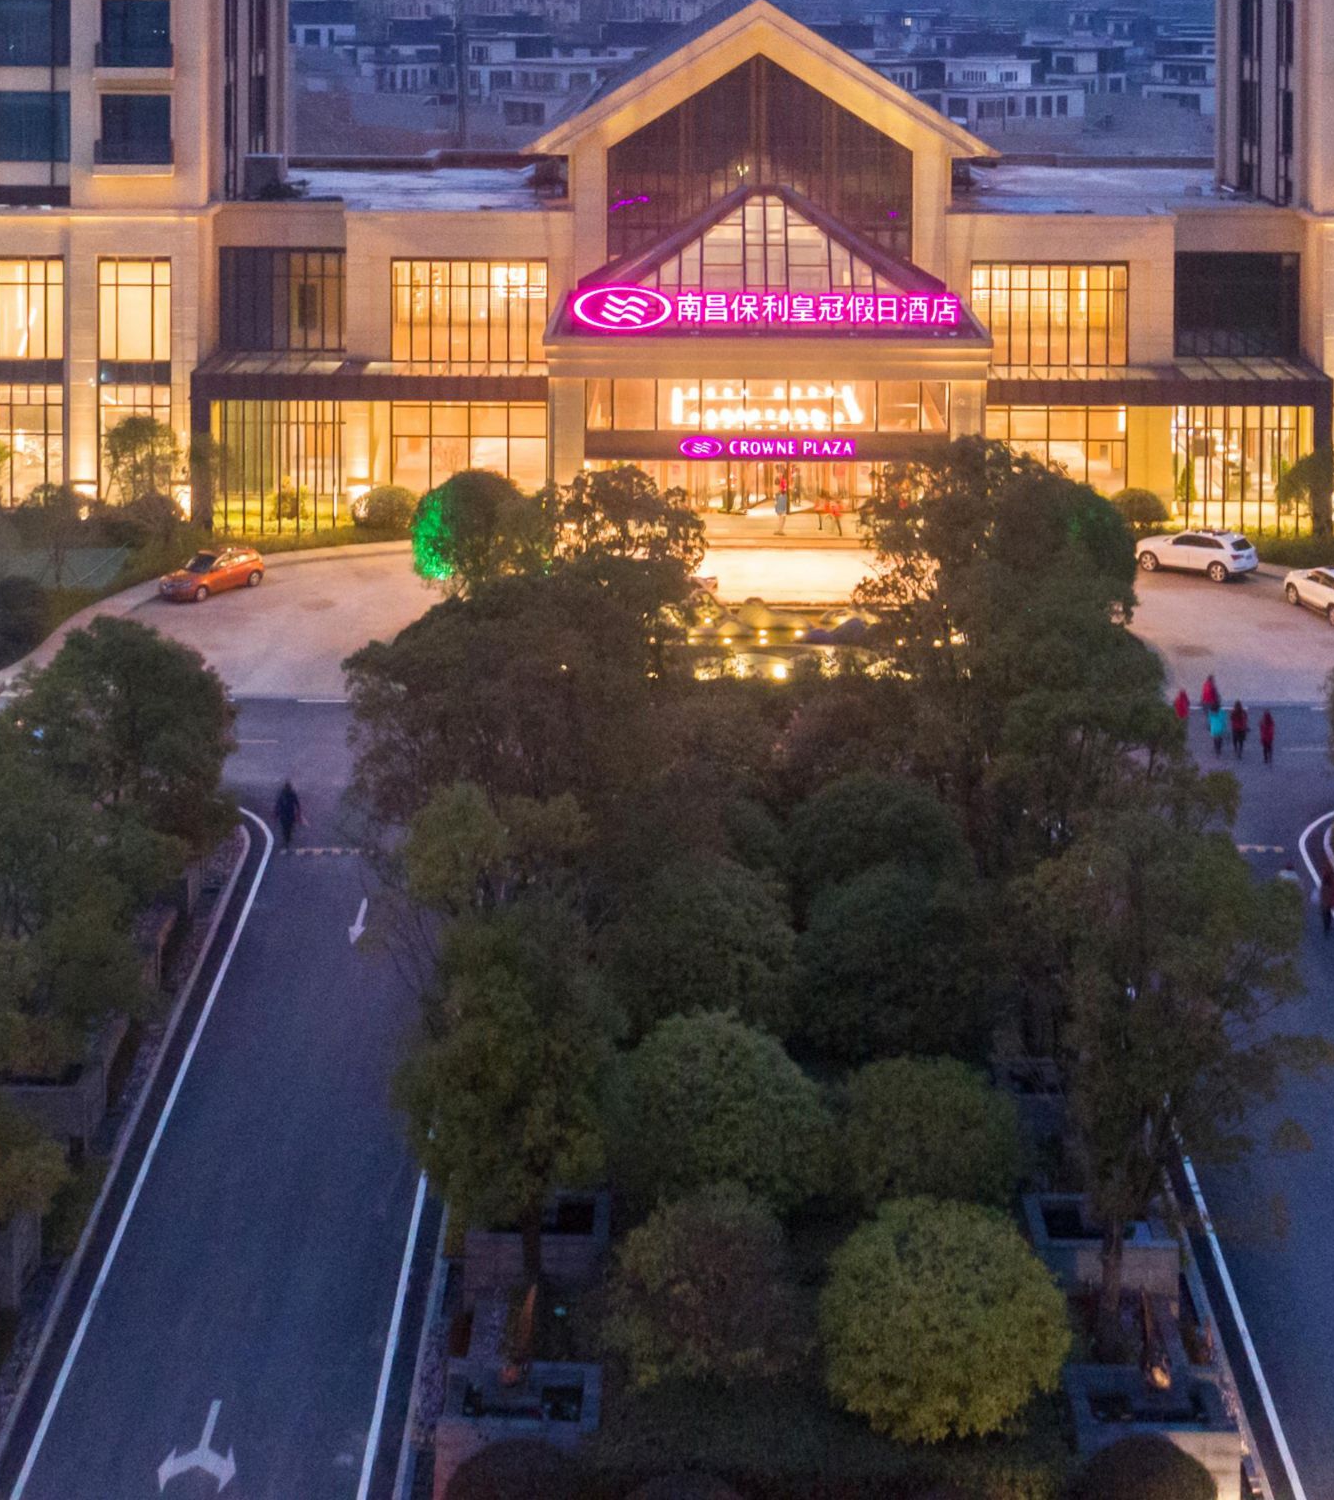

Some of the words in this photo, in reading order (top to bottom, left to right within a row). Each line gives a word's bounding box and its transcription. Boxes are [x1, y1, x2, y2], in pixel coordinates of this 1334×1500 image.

[676, 293, 957, 324] 南昌保利皇冠假日酒店
[729, 440, 795, 456] CROWNE
[803, 440, 854, 455] PLAZA
